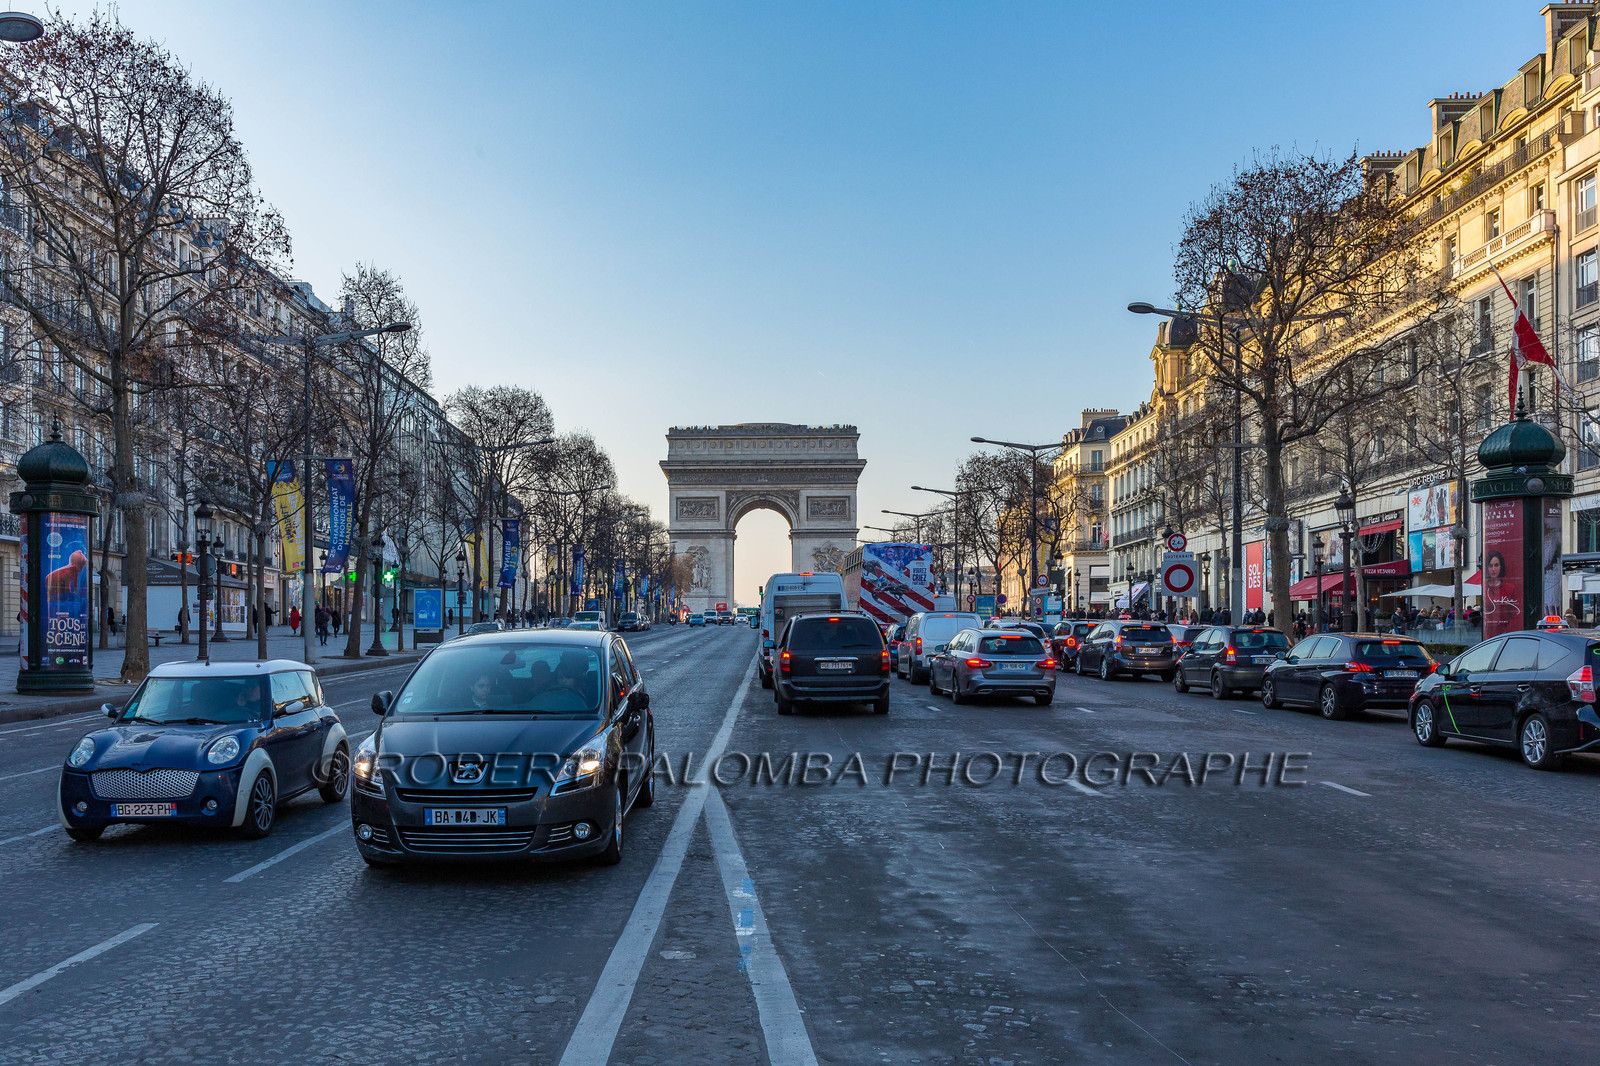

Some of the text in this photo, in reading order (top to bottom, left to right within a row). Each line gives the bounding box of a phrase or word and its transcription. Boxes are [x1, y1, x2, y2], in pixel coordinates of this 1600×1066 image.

[1422, 470, 1446, 483] GEORGE
[340, 495, 346, 509] DE
[344, 501, 353, 546] HANDBALL
[337, 538, 345, 551] DU
[49, 617, 80, 631] TOUS
